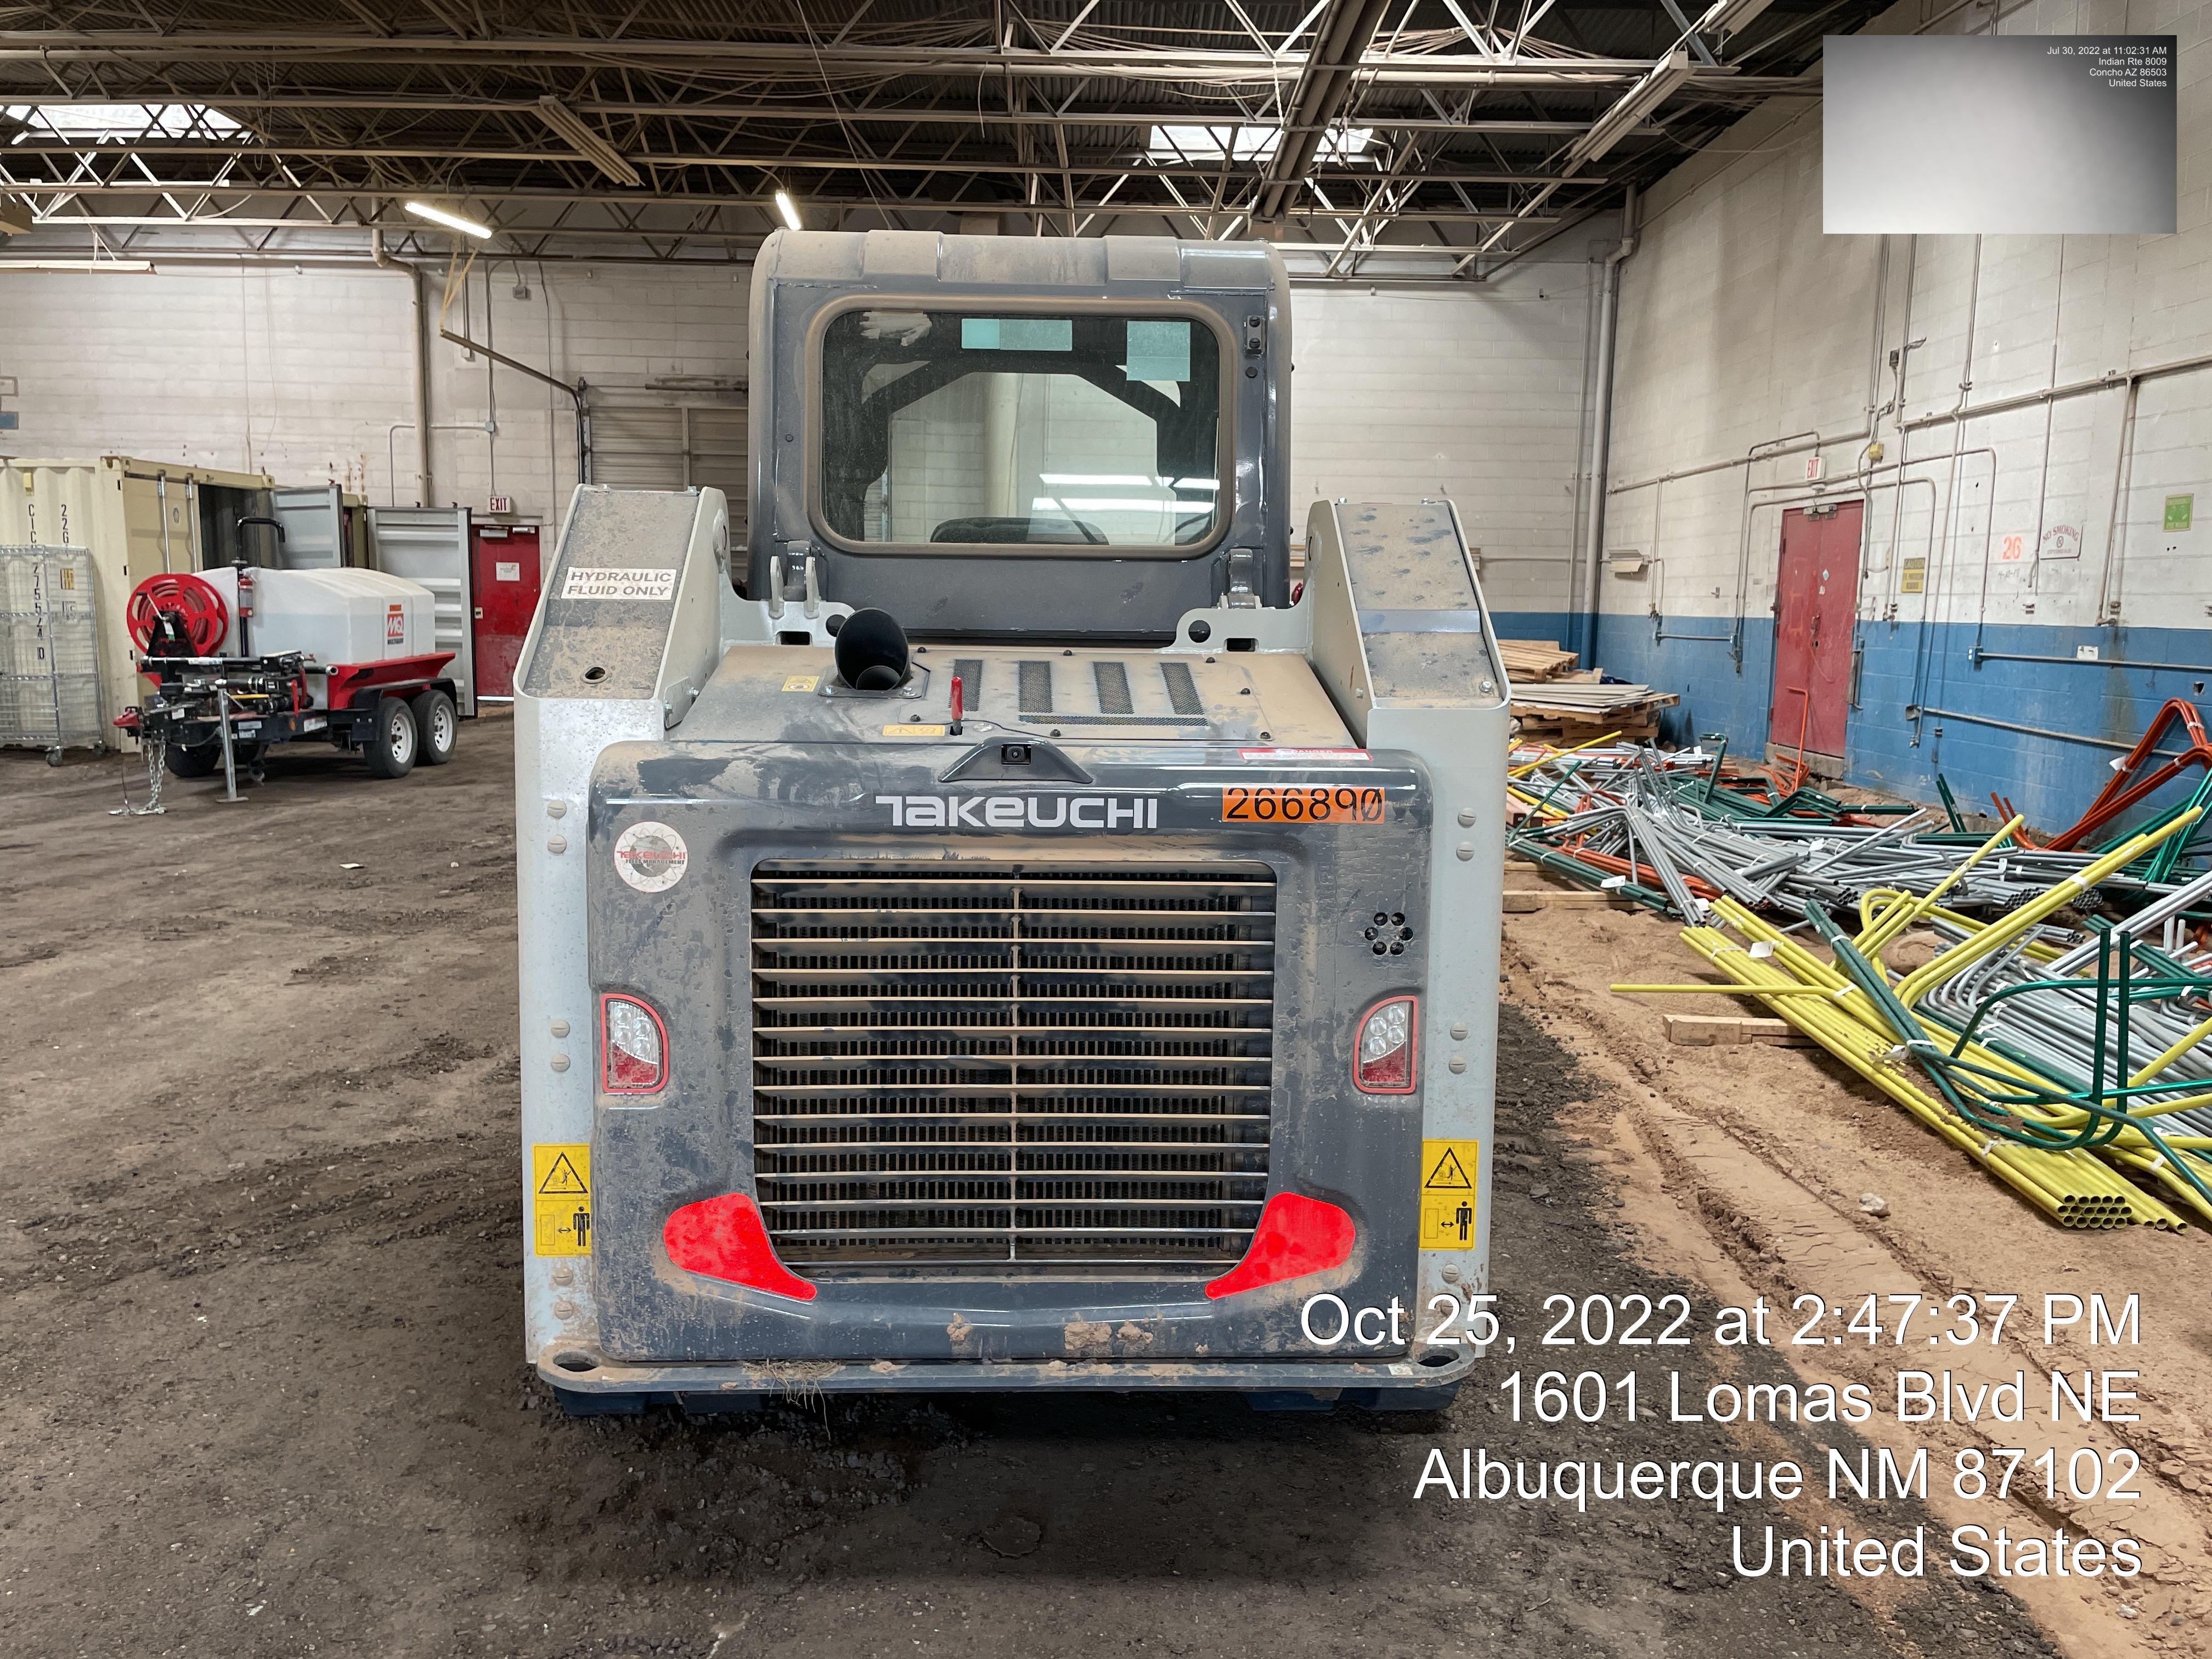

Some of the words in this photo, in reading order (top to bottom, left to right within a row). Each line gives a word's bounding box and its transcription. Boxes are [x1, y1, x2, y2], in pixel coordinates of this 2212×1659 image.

[1807, 459, 1819, 478] EXIT
[490, 497, 507, 511] EXIT
[2043, 531, 2052, 543] NO
[2053, 524, 2079, 541] SMOKING
[2002, 535, 2022, 560] 26
[571, 572, 671, 582] HYDRAULIC
[567, 585, 618, 595] FLUID
[623, 586, 668, 596] ONLY
[875, 795, 1158, 829] TAKEUCHI
[1226, 787, 1383, 822] 266890
